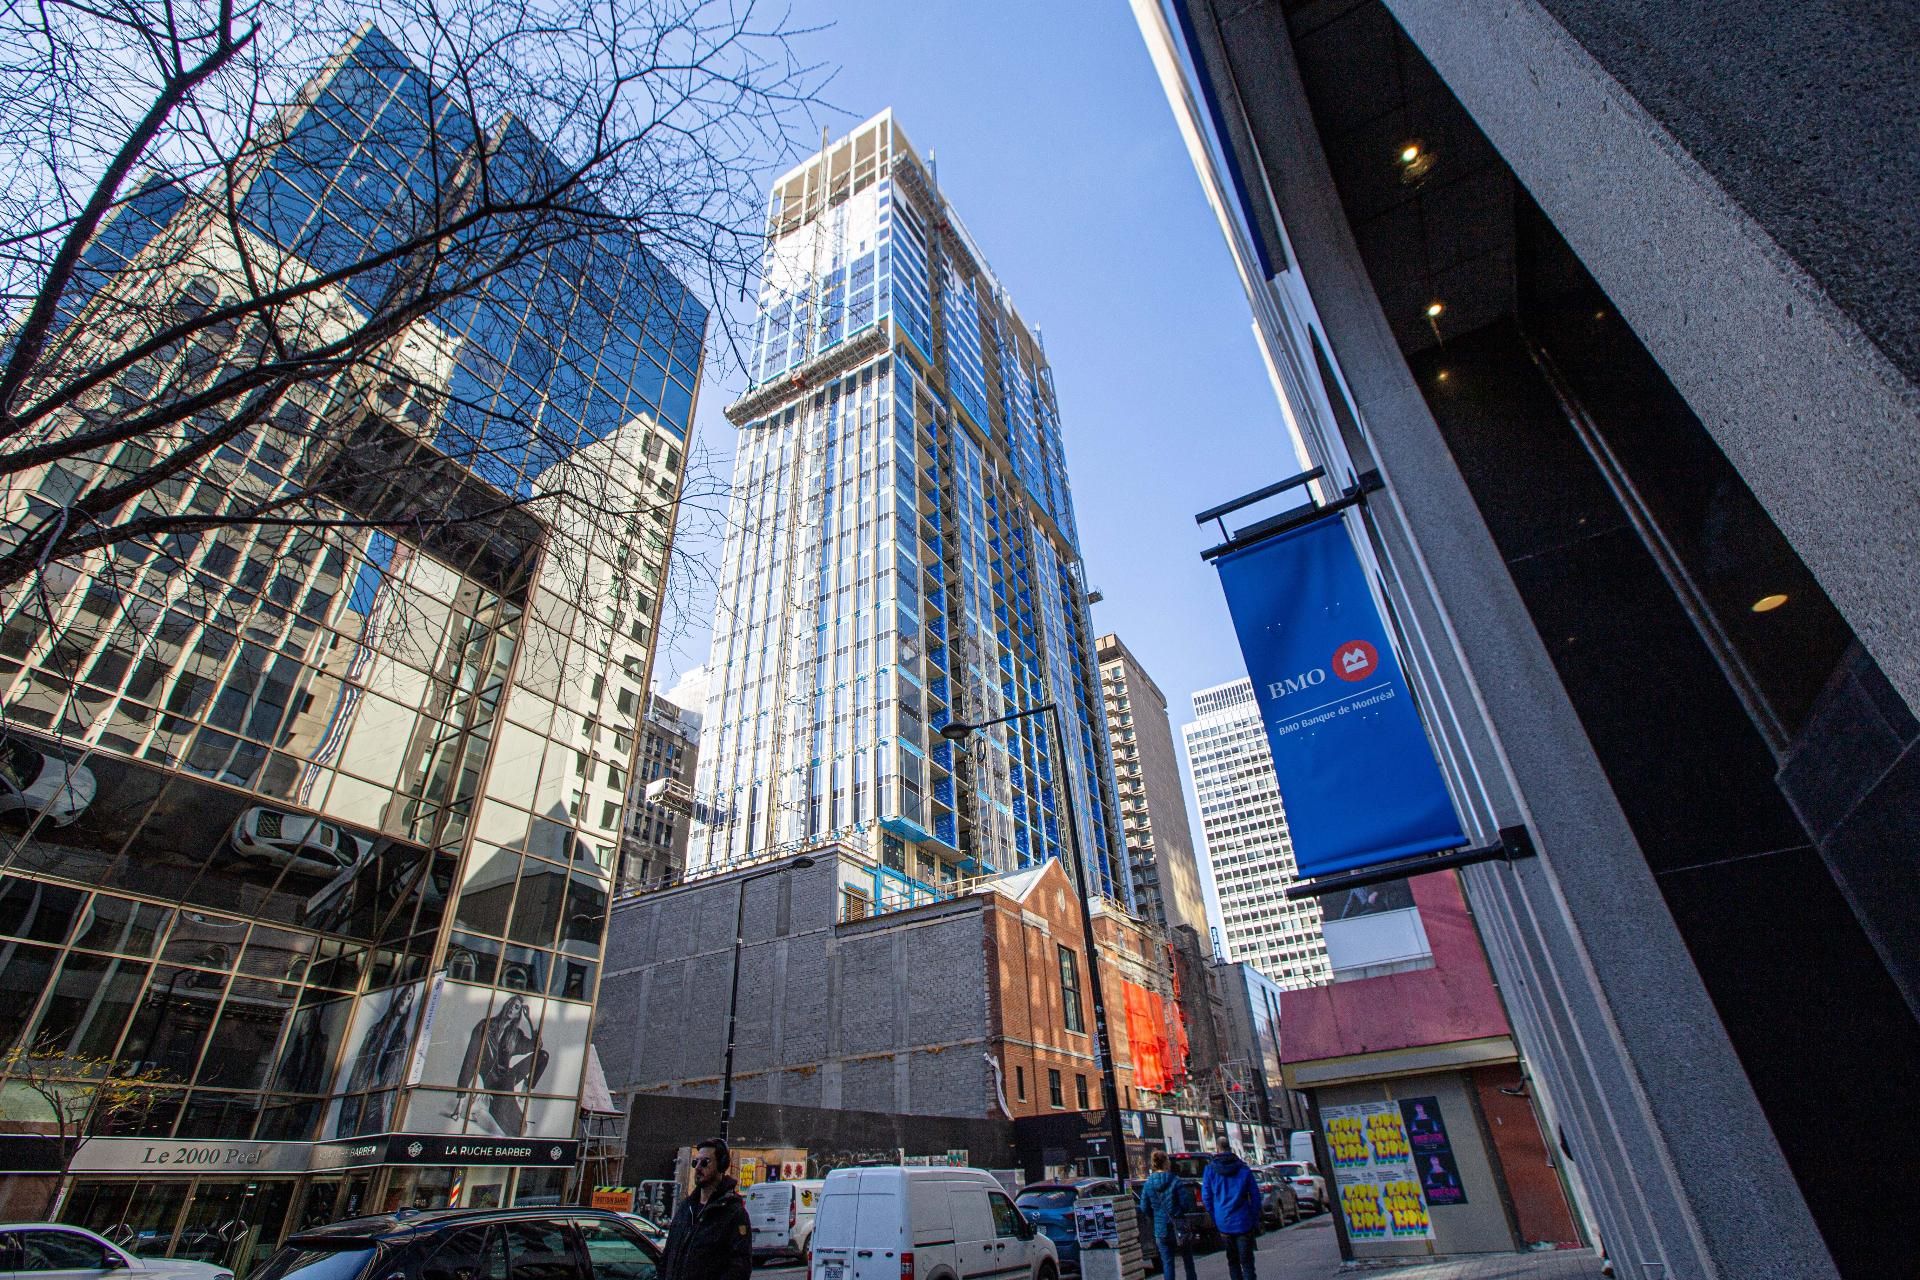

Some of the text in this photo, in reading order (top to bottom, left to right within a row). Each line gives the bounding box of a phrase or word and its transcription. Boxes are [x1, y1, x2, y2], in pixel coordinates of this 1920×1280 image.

[1267, 668, 1326, 700] BMO
[1279, 688, 1395, 736] BMO Banque de Montréal
[141, 1147, 262, 1164] Le 2000 Peel
[445, 1145, 532, 1157] LA RUCHE BARBER
